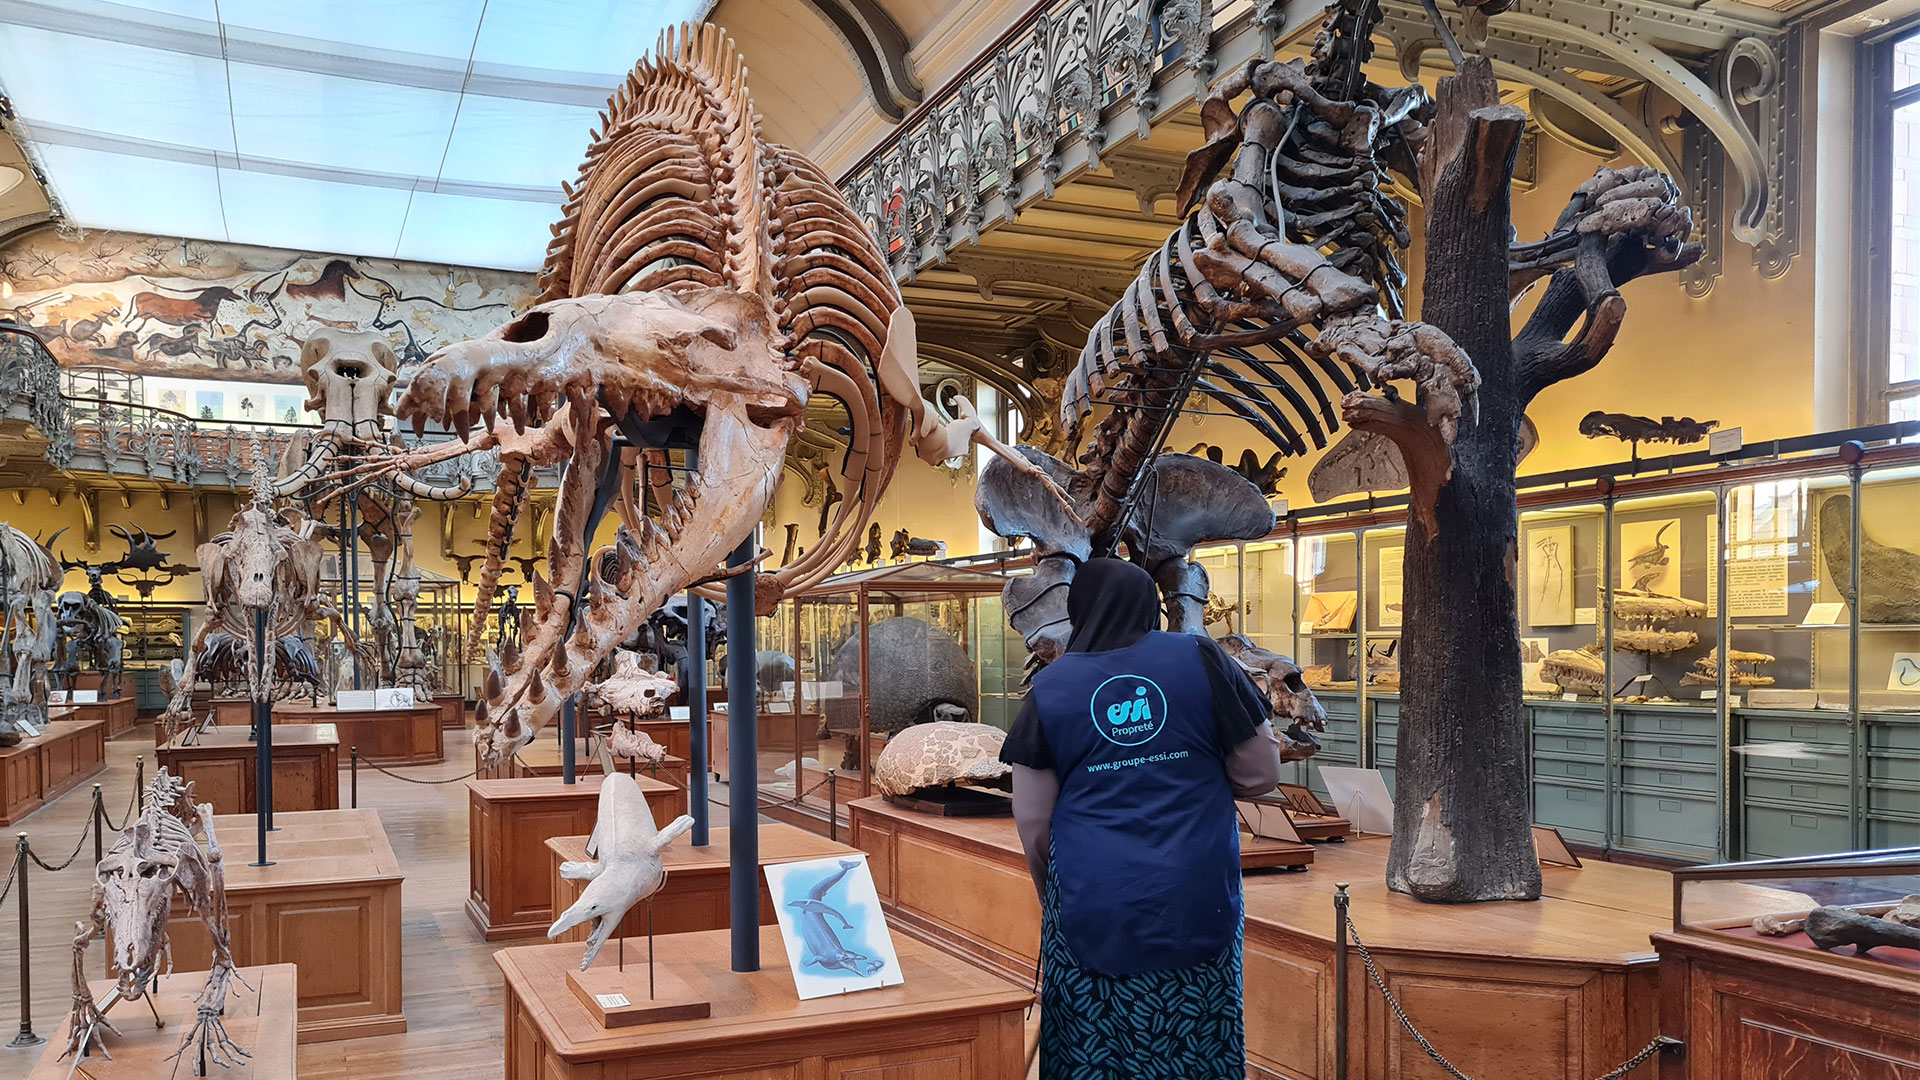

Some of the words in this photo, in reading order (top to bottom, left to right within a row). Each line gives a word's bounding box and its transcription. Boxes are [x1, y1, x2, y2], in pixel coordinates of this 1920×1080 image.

[1107, 686, 1151, 725] essi
[1111, 721, 1154, 737] Propreté
[1087, 750, 1189, 773] www.groupe-essi.com
